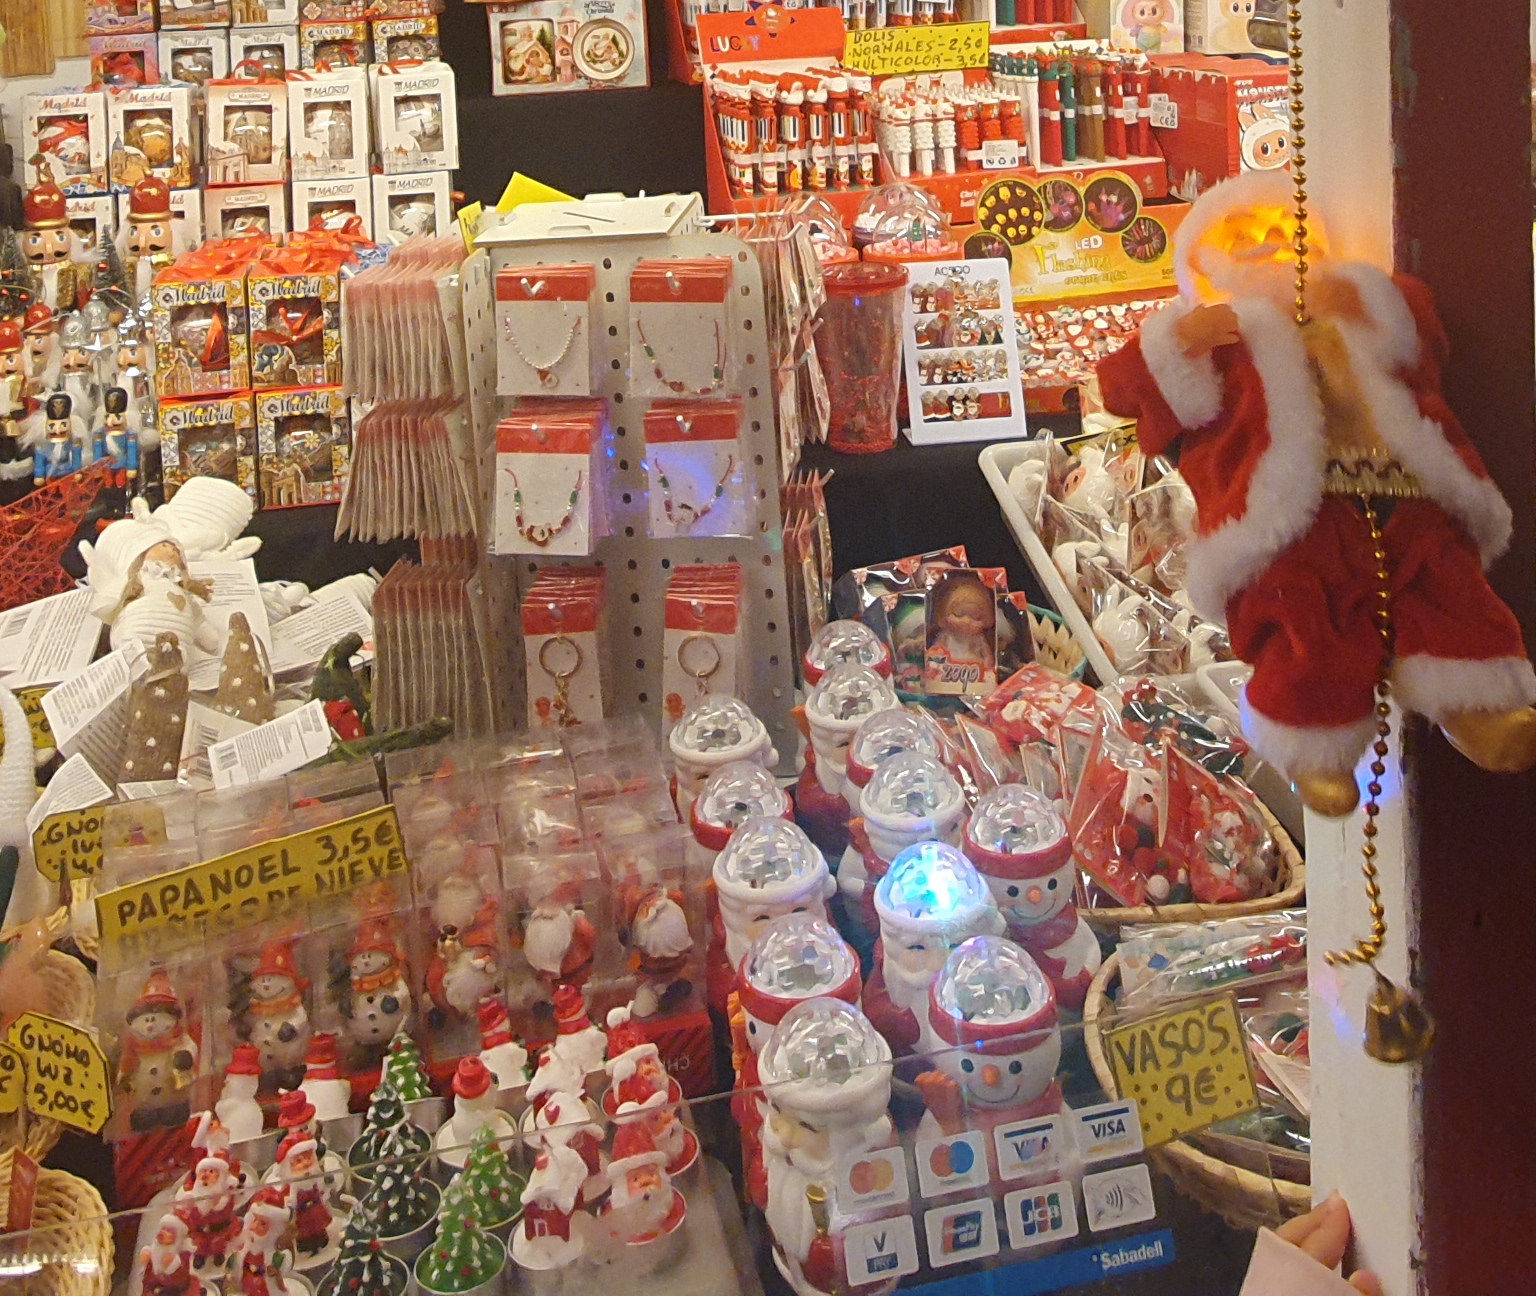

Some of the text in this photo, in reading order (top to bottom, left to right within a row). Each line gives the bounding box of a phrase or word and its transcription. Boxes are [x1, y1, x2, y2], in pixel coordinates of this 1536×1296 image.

[710, 34, 761, 54] LUCKY
[853, 30, 895, 44] BOLIS
[852, 39, 935, 58] NORMALES
[313, 85, 350, 97] MADRID
[404, 78, 440, 90] MADRID
[1074, 235, 1103, 250] LED
[116, 878, 206, 927] PAPA
[208, 847, 302, 903] NOEL
[1114, 1005, 1231, 1075] VASOS
[1165, 1066, 1218, 1116] 9€
[1091, 1118, 1127, 1140] VISA
[1100, 1240, 1164, 1268] Sabadell
